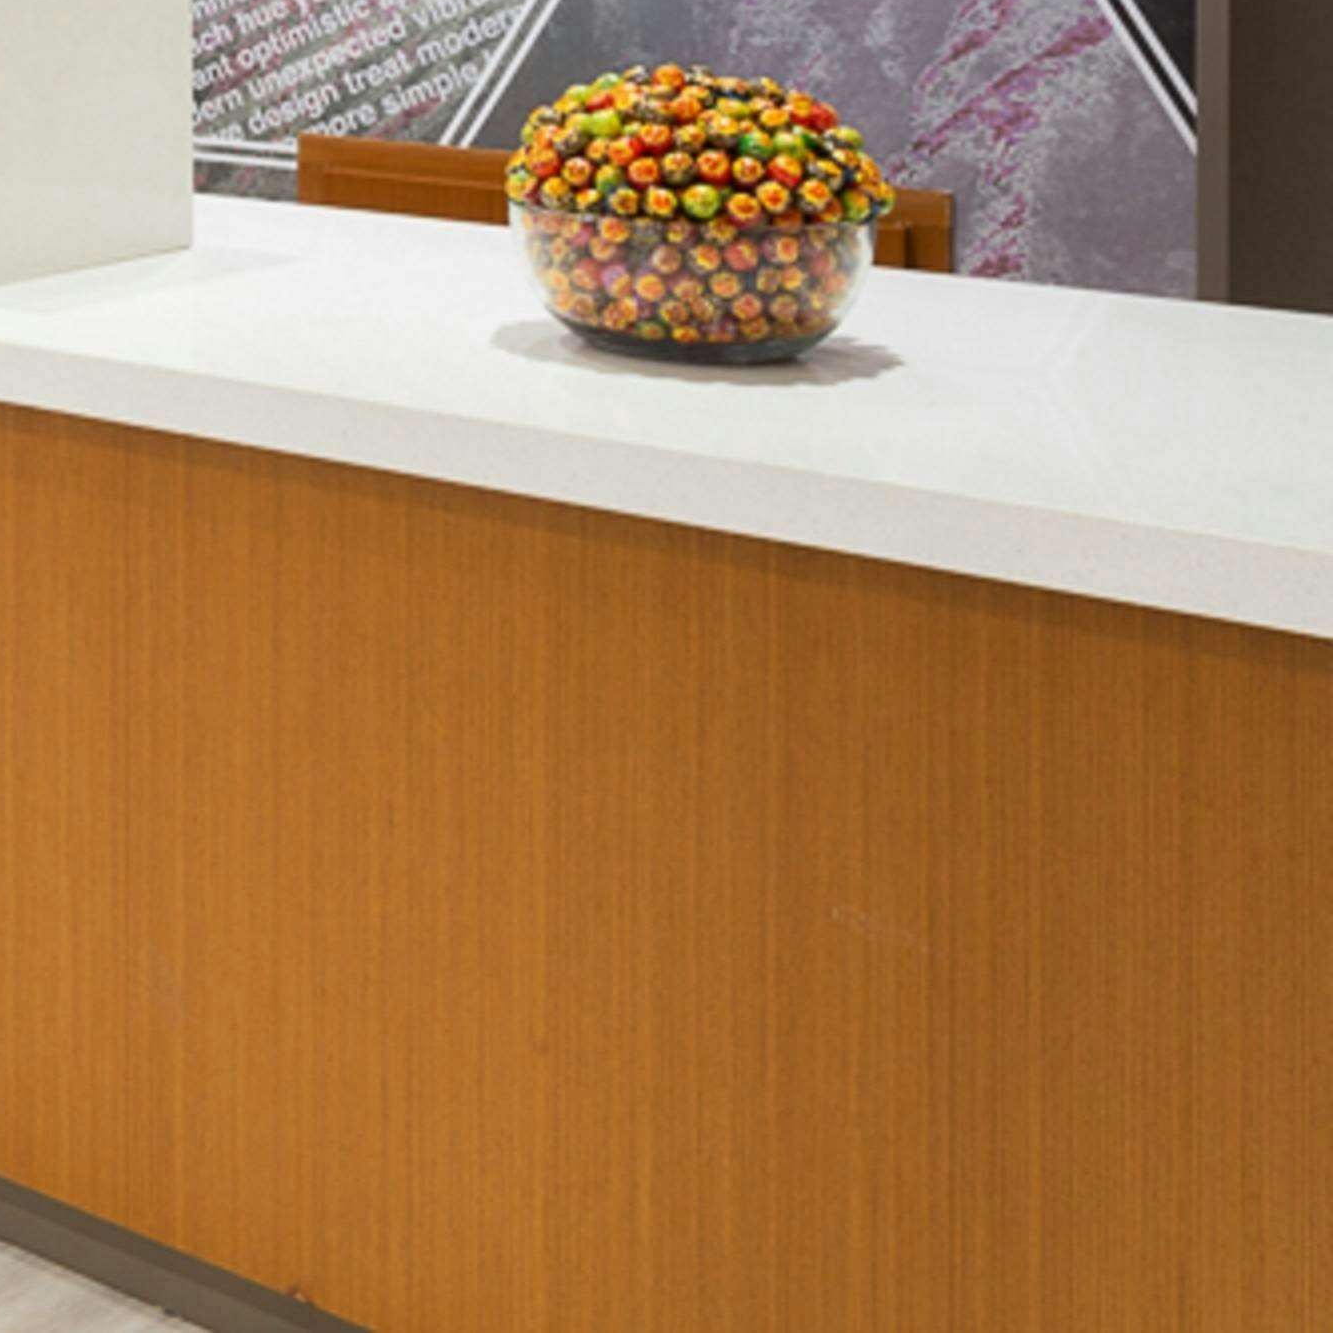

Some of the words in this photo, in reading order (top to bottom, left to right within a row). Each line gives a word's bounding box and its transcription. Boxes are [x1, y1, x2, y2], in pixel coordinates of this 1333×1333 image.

[246, 83, 338, 134] design
[342, 50, 412, 95] treat
[247, 14, 406, 99] unexpected
